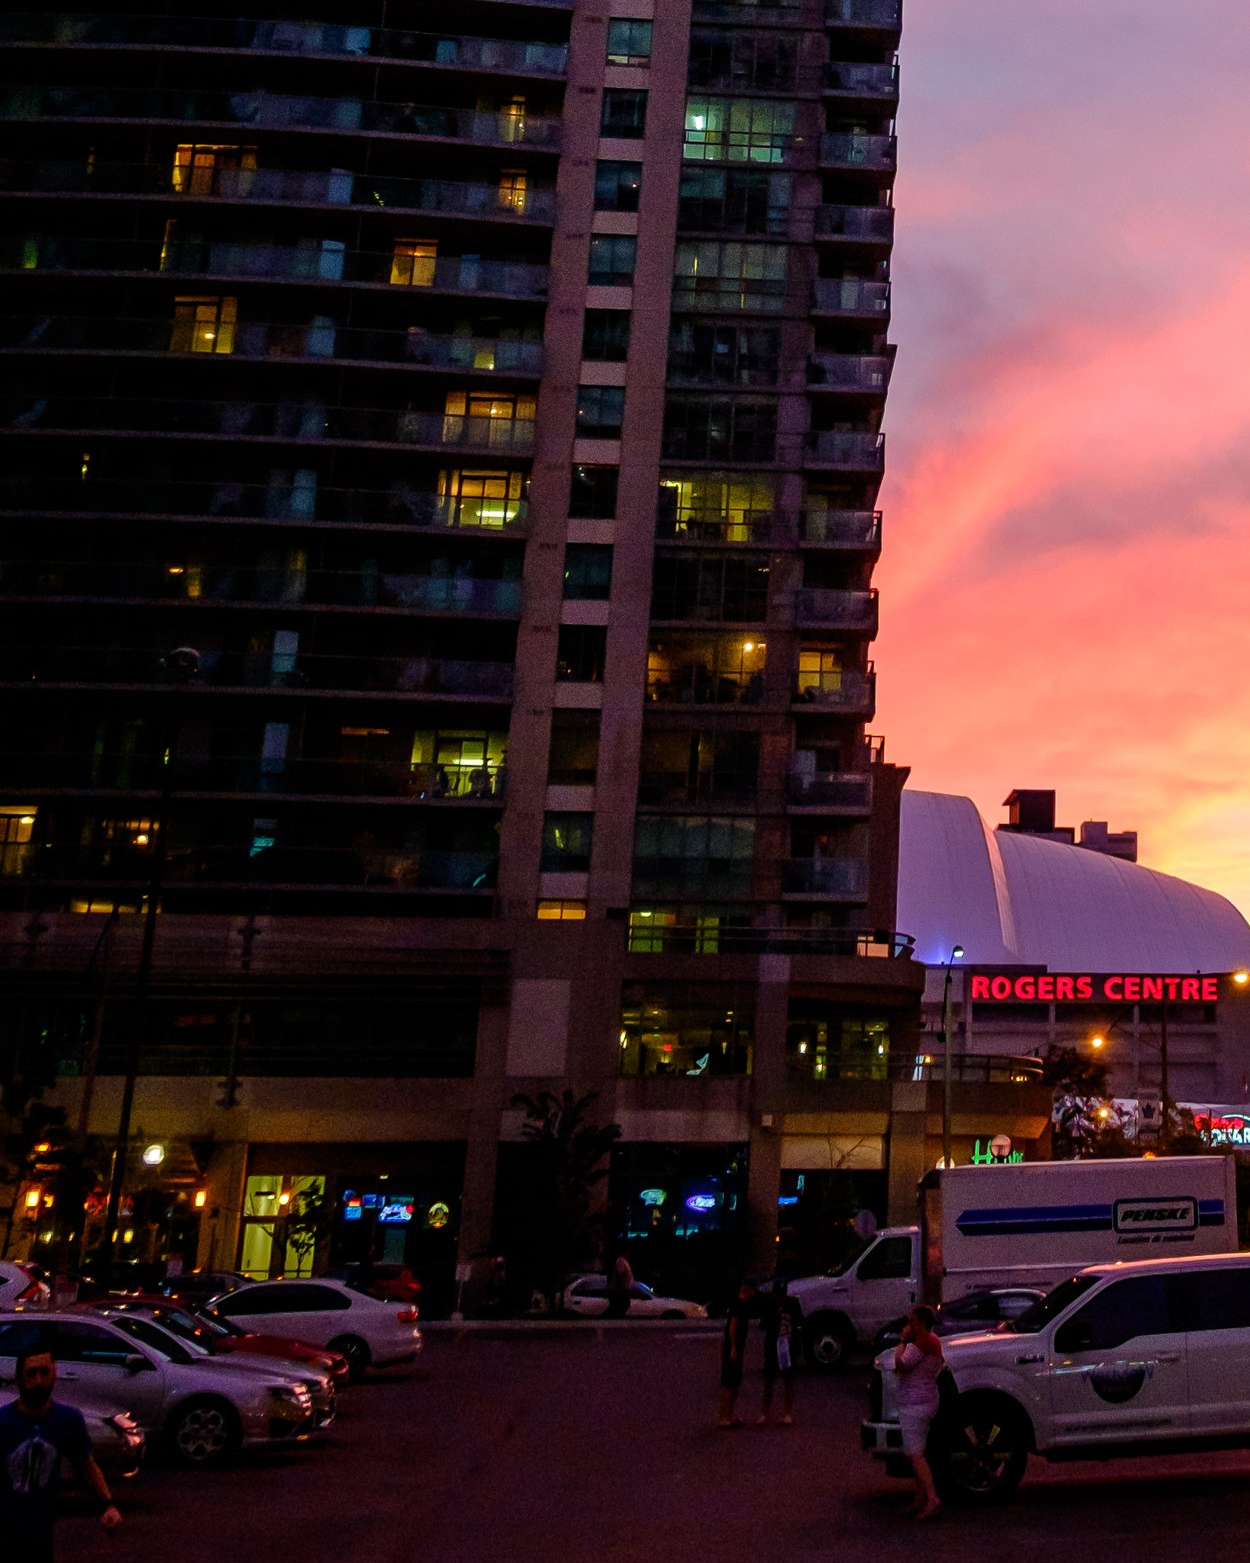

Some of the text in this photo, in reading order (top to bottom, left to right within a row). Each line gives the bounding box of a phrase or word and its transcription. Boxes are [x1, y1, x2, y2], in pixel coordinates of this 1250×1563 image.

[971, 975, 1218, 1000] ROGERS CENTRE
[1120, 1207, 1190, 1222] PENSKE
